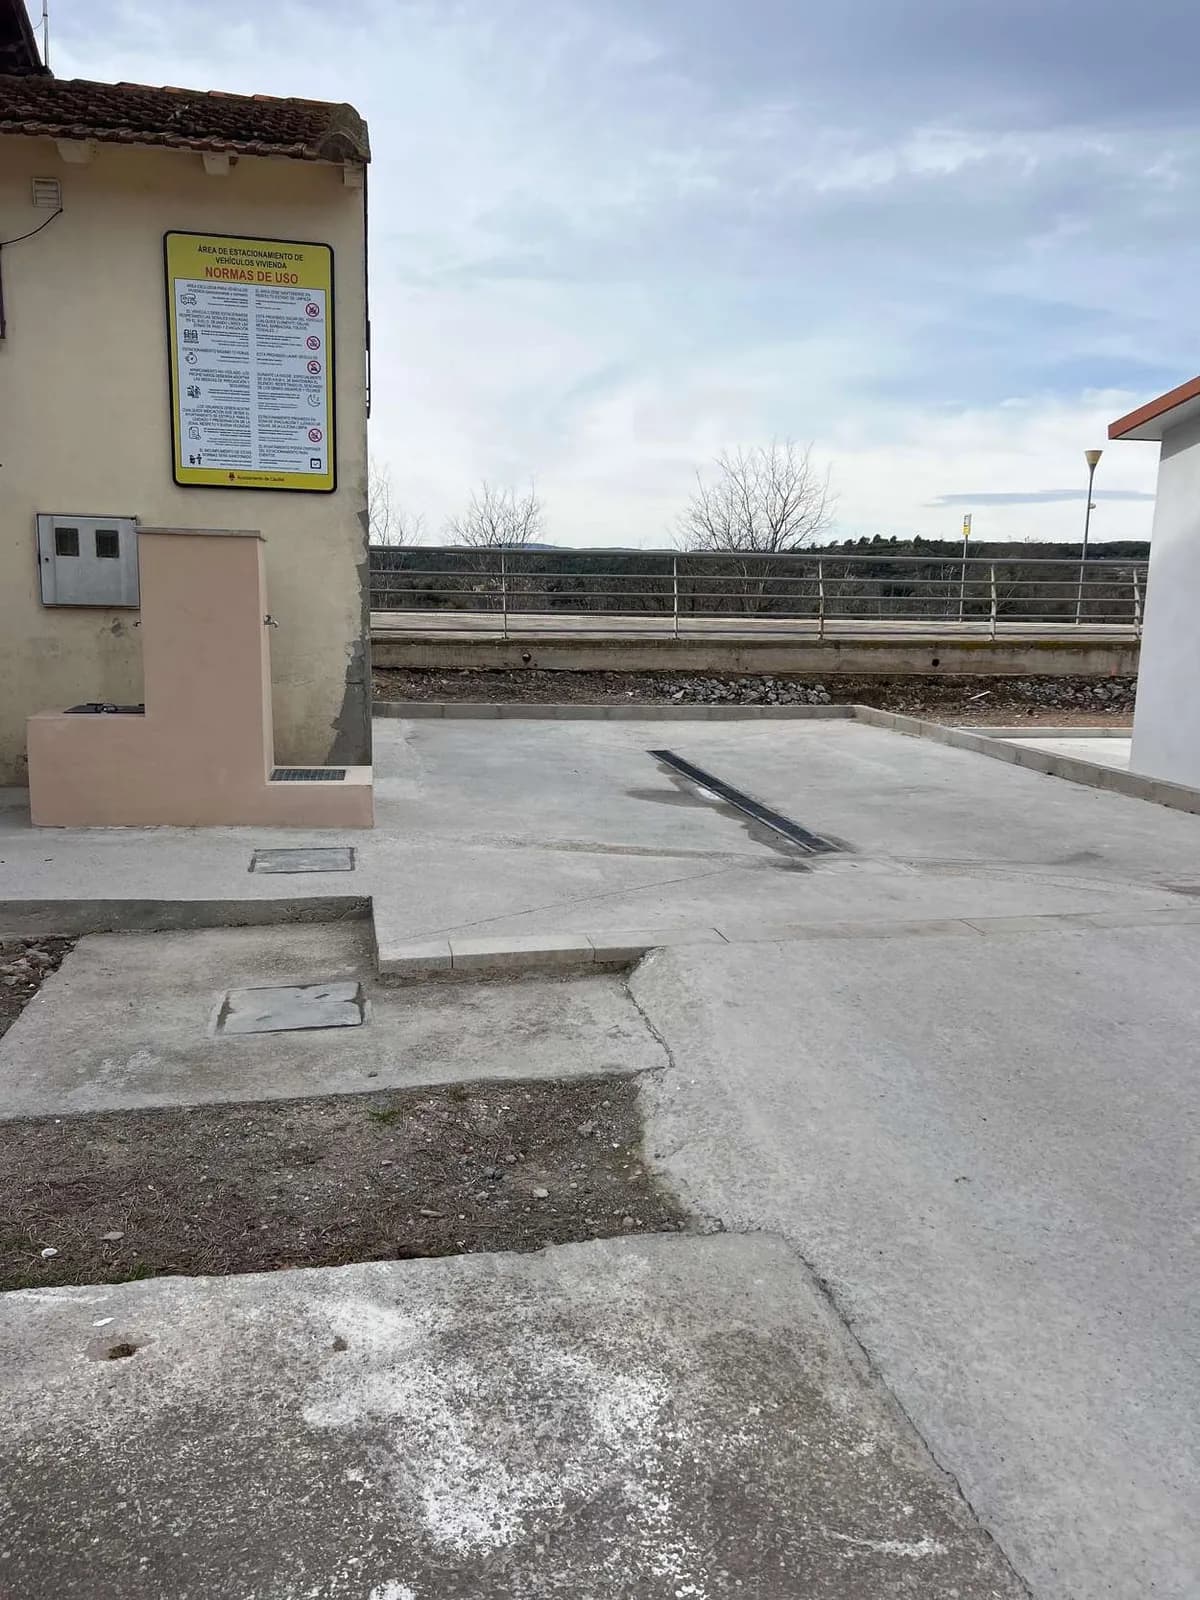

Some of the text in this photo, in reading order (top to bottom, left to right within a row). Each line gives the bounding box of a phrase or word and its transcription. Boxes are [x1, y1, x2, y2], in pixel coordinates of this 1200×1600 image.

[198, 244, 217, 254] ÁREA
[229, 248, 293, 260] ESTACIONAMIENTO
[216, 256, 287, 269] VEHÍCULOS VIVIENDA
[206, 266, 298, 284] NORMAS DE USO
